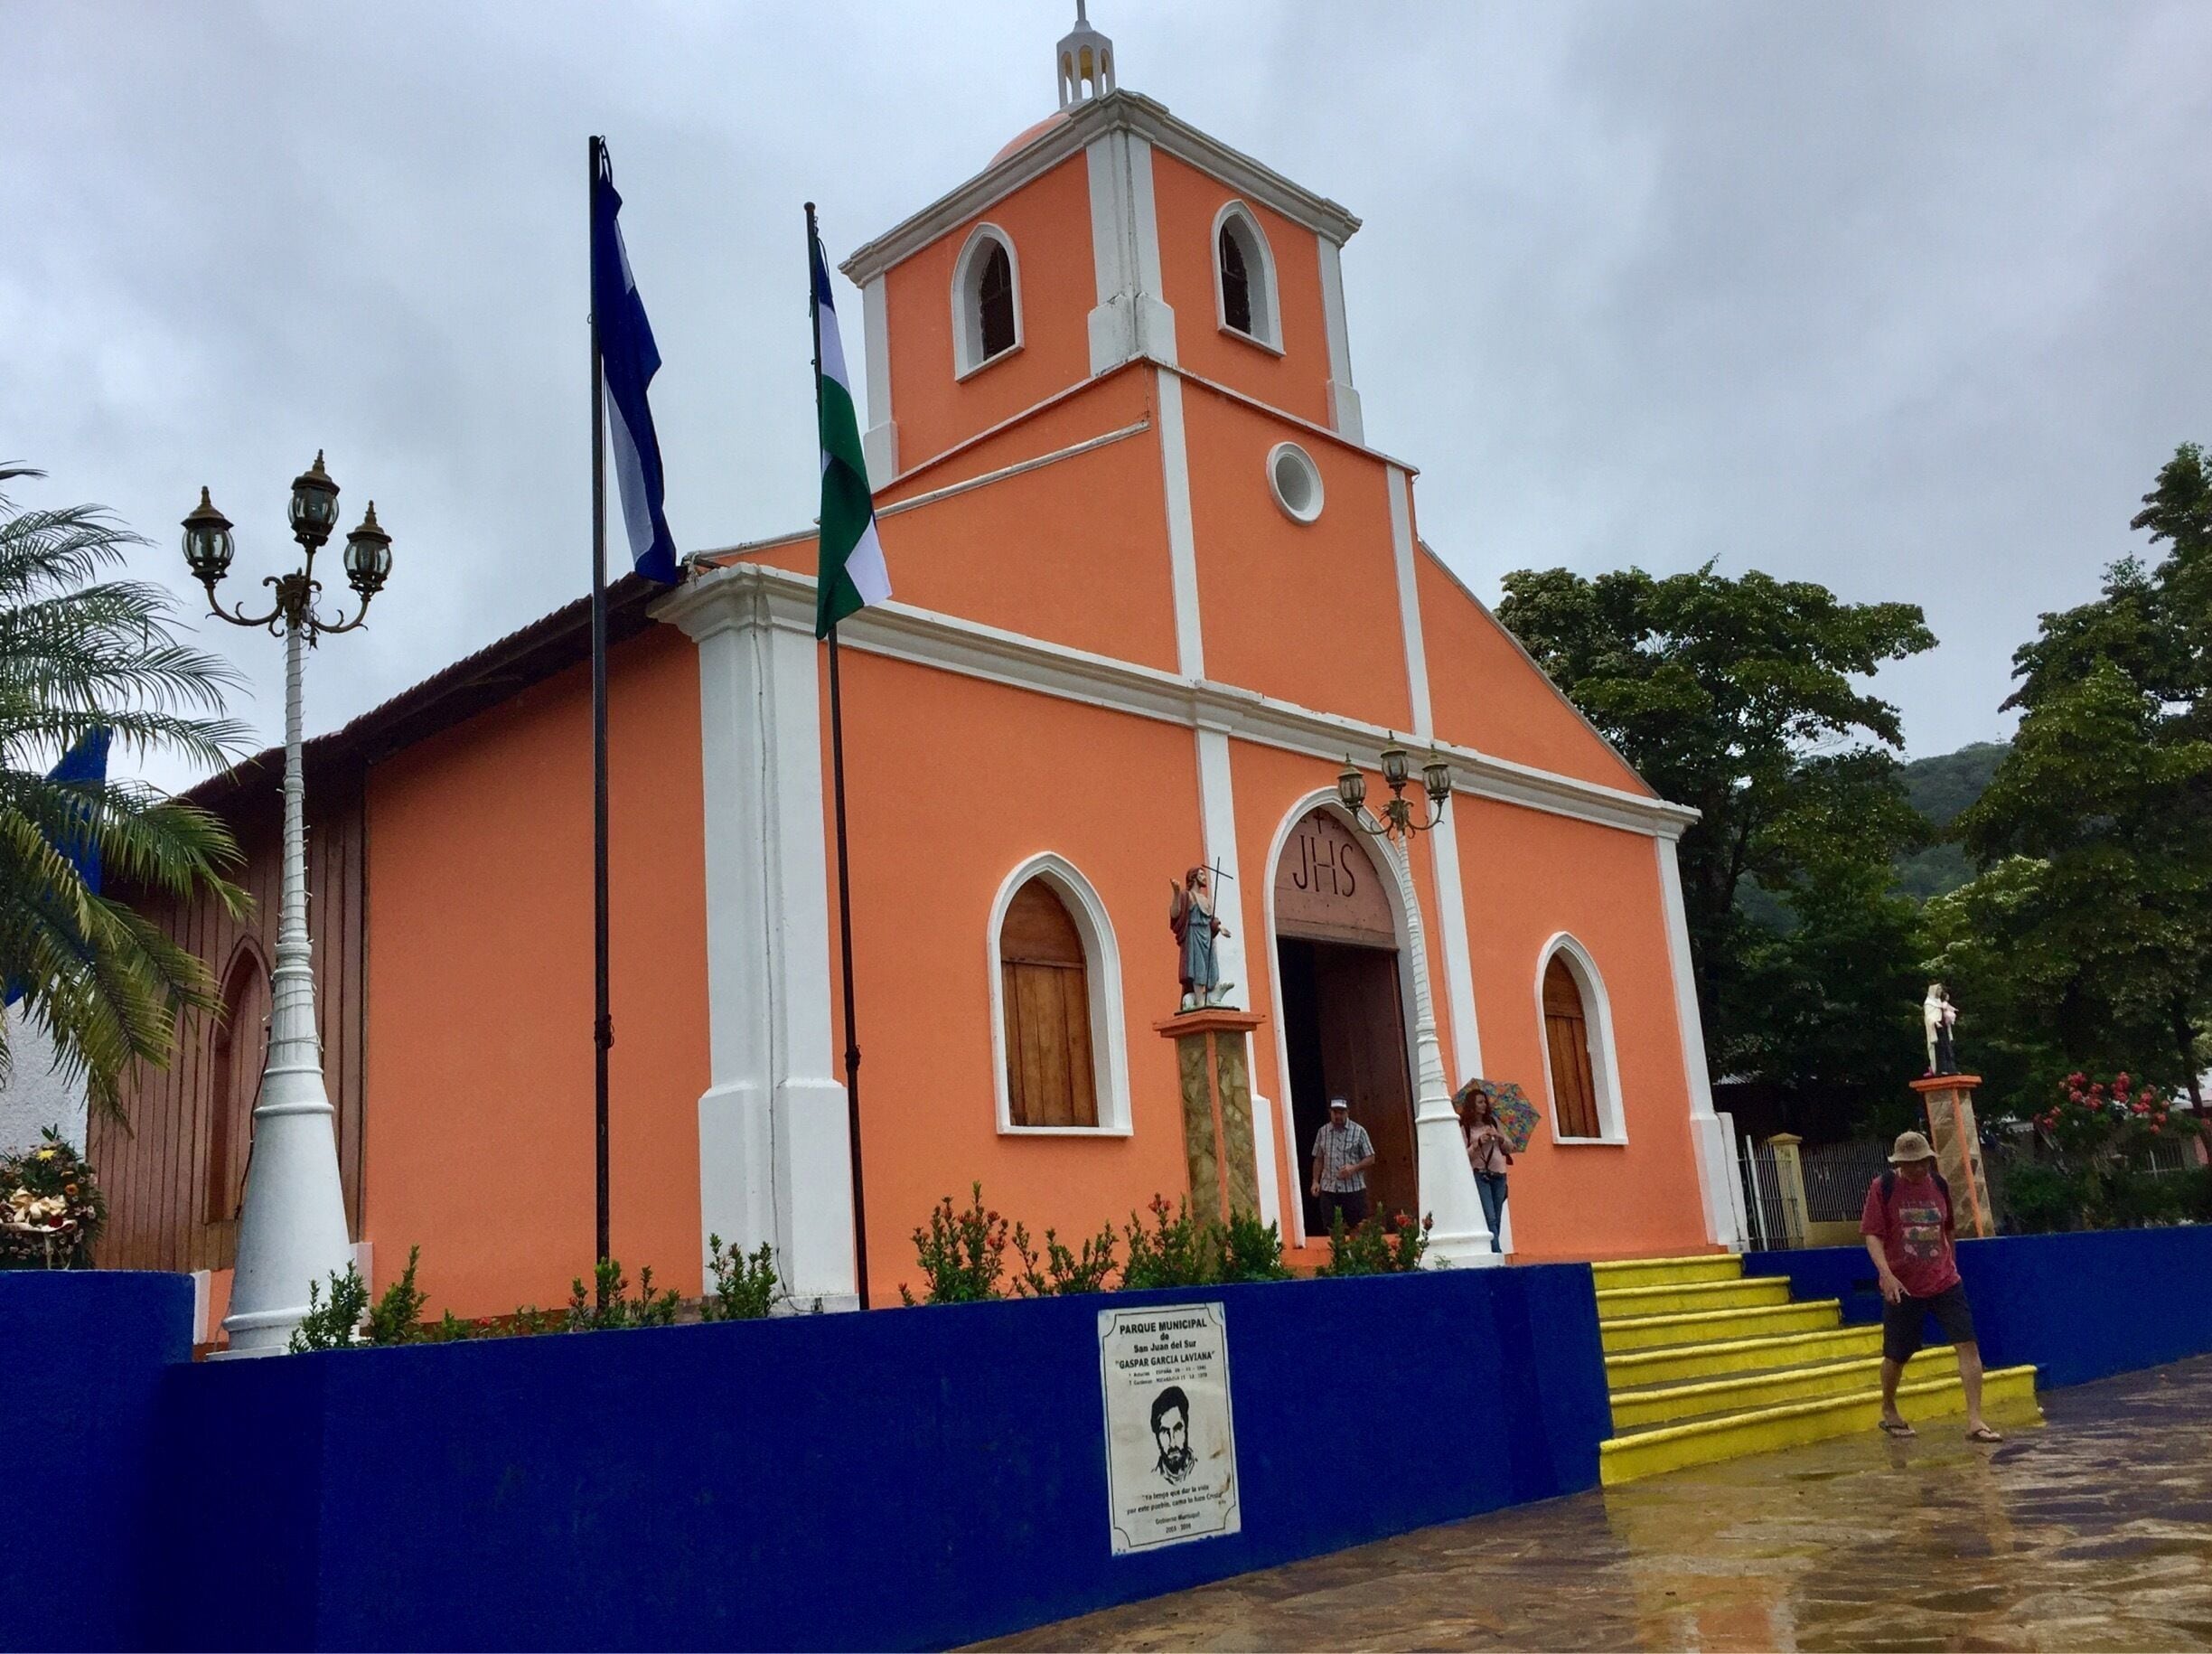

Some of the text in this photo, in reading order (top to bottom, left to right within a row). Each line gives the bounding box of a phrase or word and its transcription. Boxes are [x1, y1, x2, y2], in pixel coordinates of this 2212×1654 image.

[1292, 835, 1355, 897] JHS
[1120, 1318, 1207, 1335] PARQUE MUNICIPAL
[1160, 1332, 1169, 1341] de
[1133, 1339, 1196, 1353] San Juan del Sur
